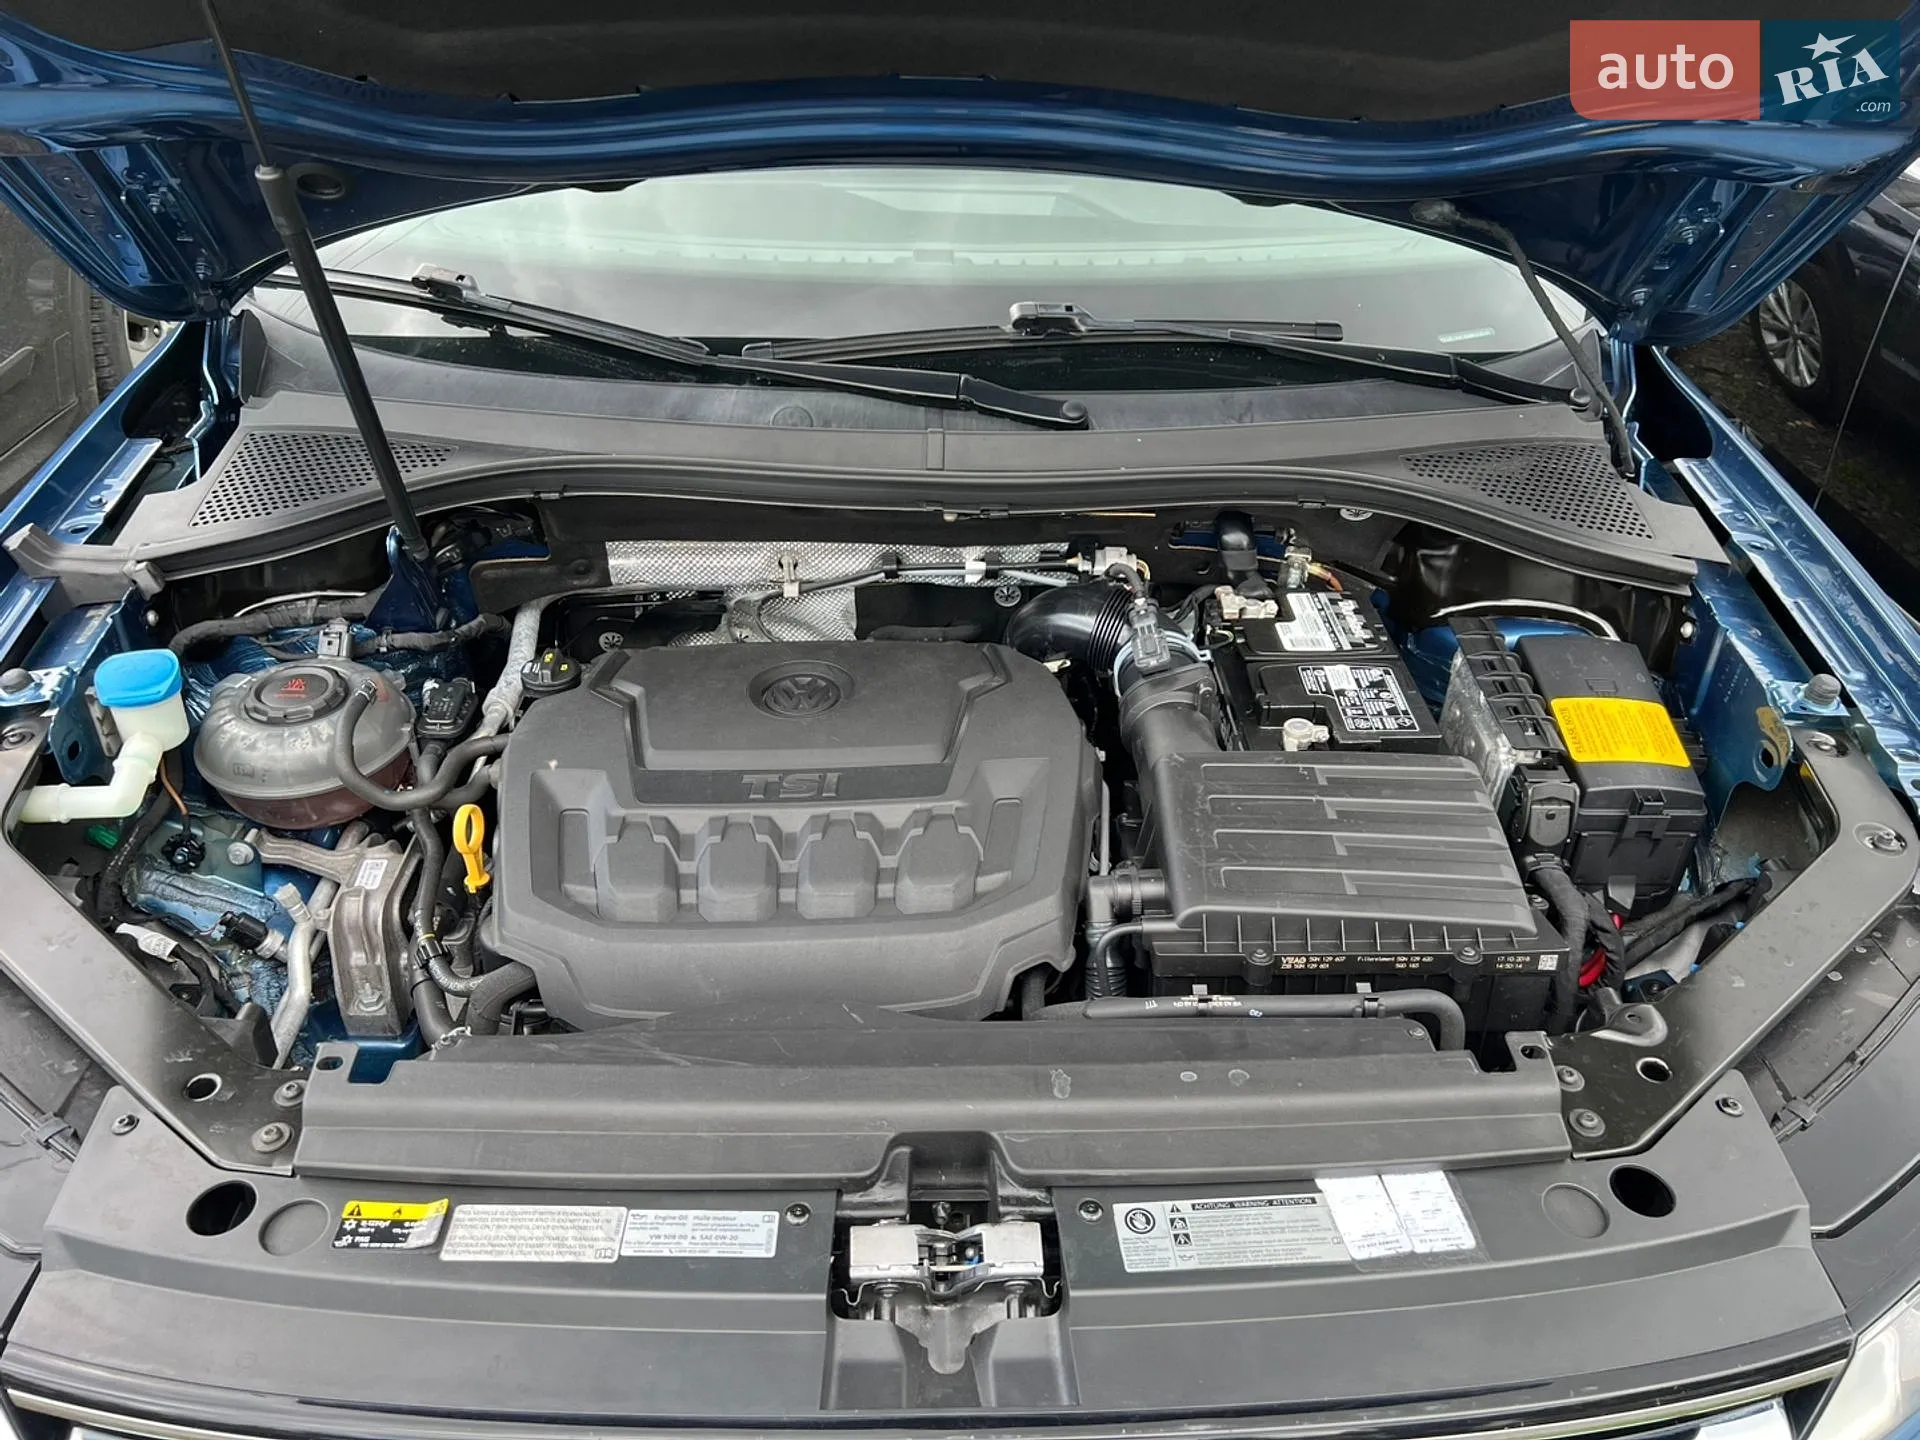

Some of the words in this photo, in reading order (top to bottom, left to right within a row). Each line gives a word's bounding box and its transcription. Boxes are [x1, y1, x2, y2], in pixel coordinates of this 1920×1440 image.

[741, 772, 843, 799] TSI
[1194, 1201, 1231, 1210] ACHTUNG
[1272, 1197, 1312, 1206] ATTENTION
